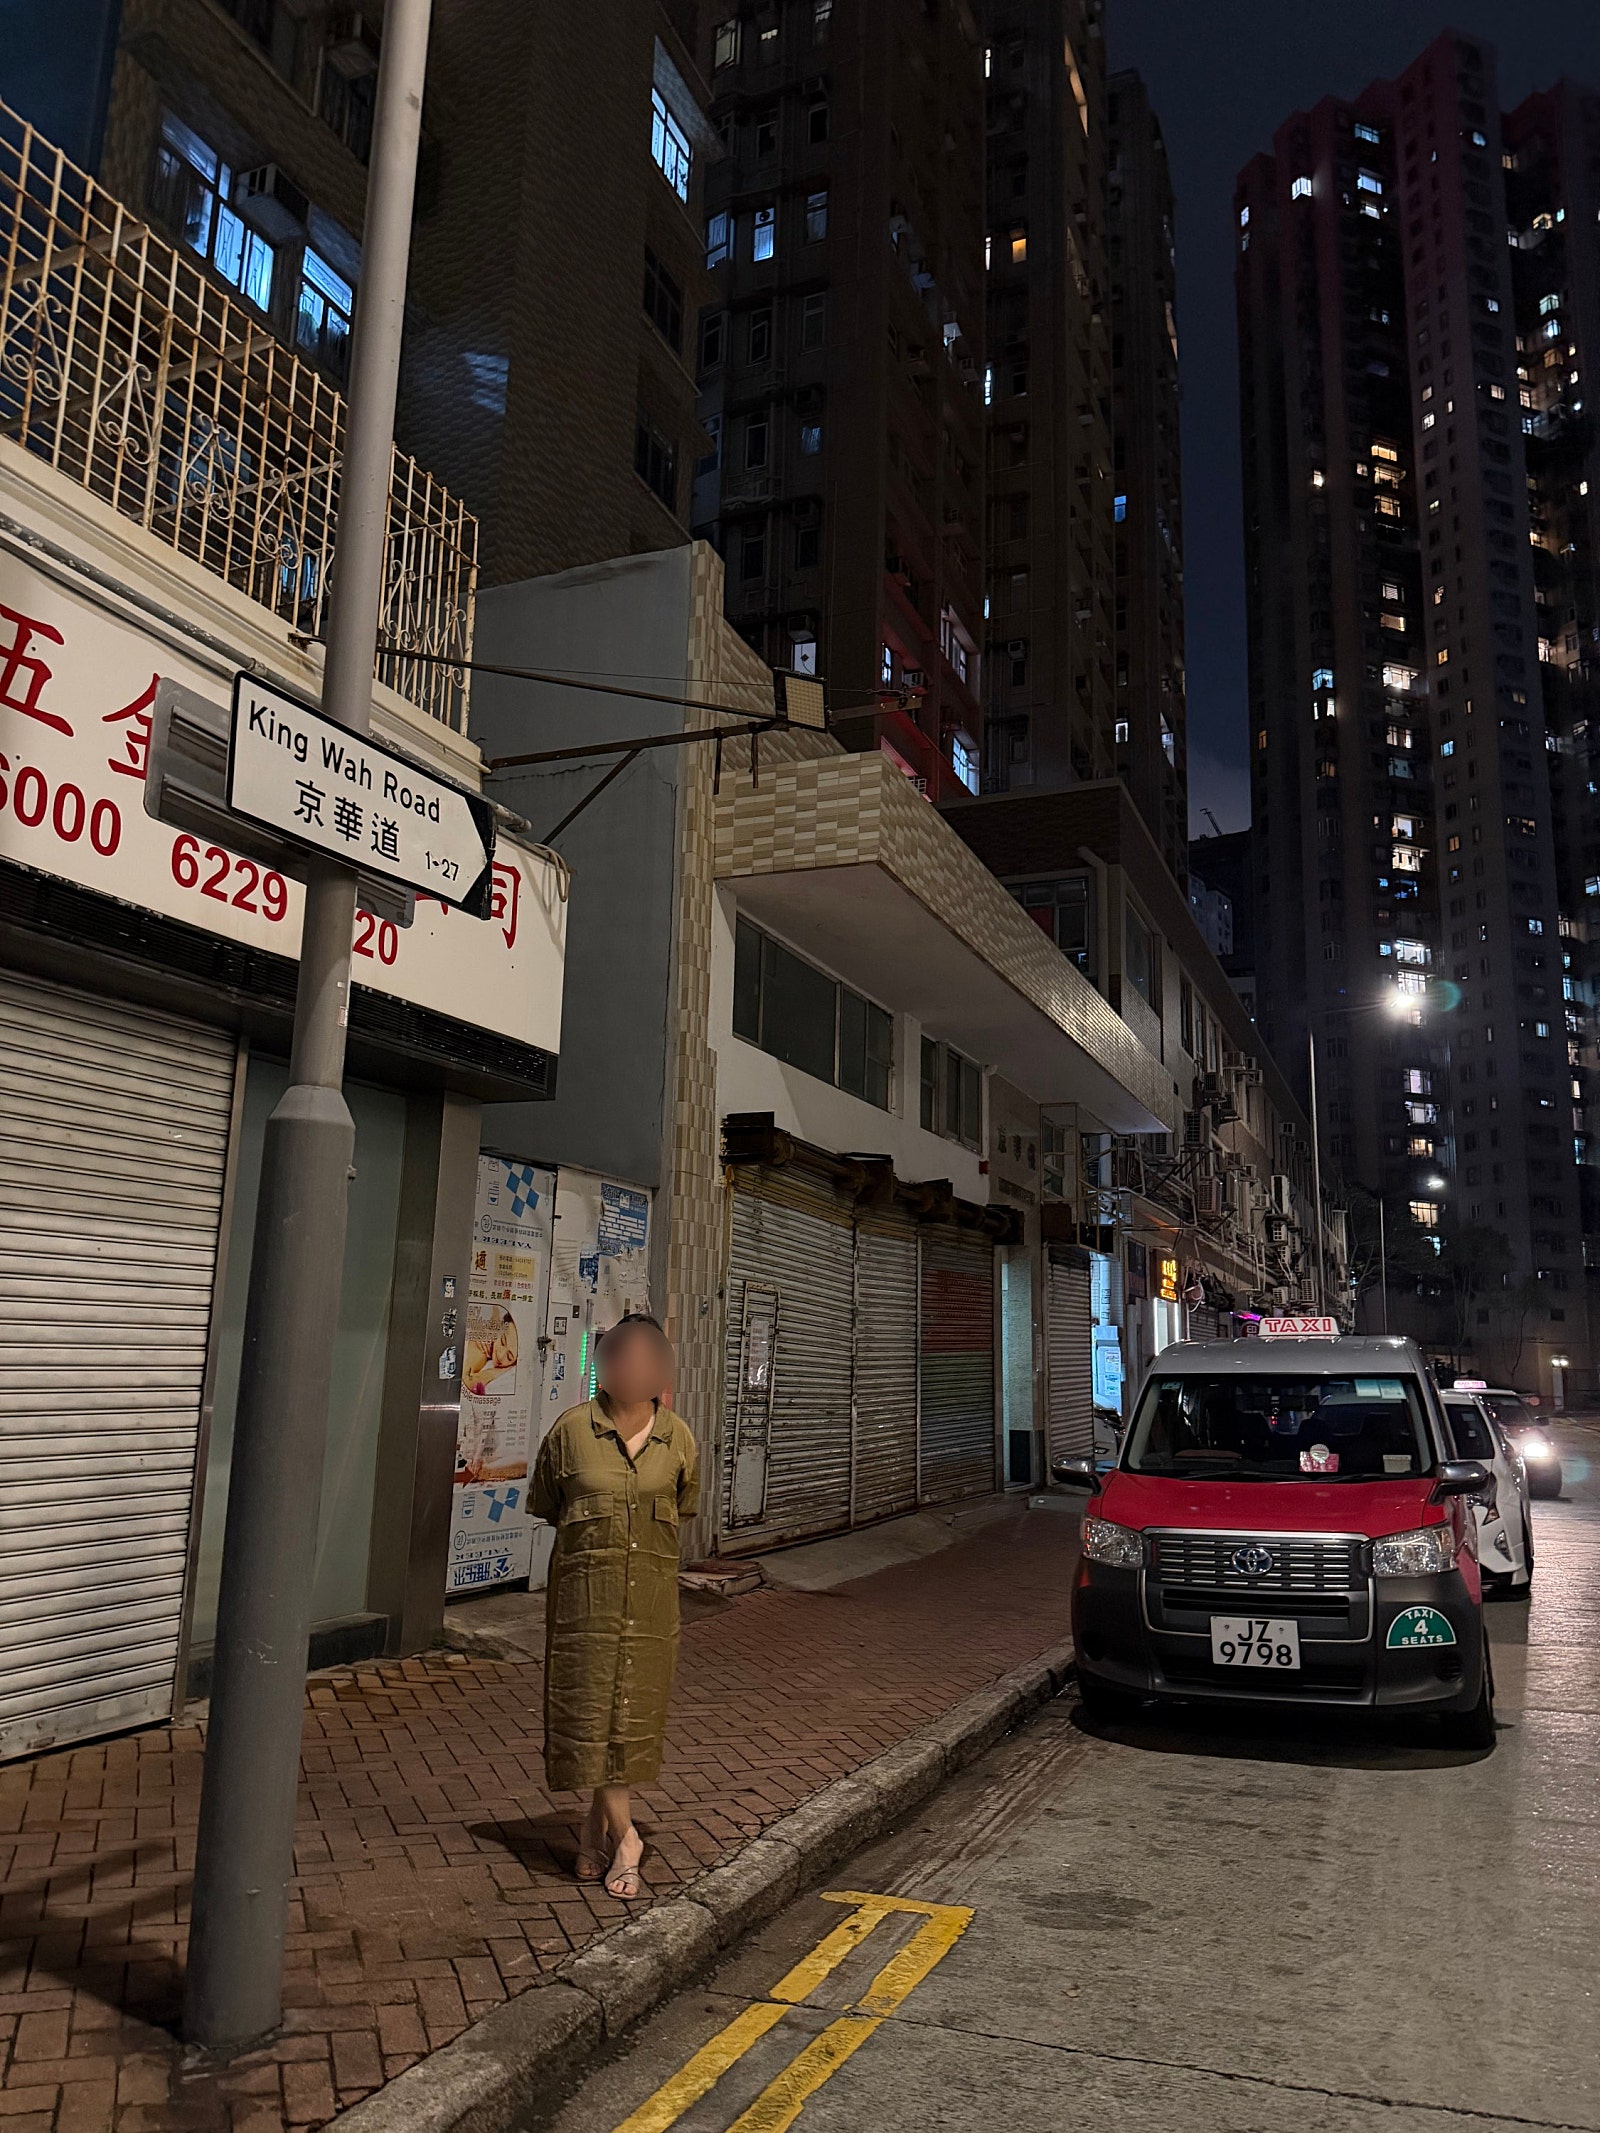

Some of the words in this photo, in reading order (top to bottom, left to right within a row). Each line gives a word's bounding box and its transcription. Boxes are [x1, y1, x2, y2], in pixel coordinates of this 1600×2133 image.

[249, 700, 309, 763] King
[321, 736, 372, 791] Wah
[383, 770, 441, 824] Road
[293, 780, 401, 863] 京華道
[0, 753, 122, 858] 000
[171, 833, 289, 923] 6229
[352, 910, 399, 966] 20
[425, 850, 460, 882] 1-27
[482, 1236, 532, 1249] YALEER
[1264, 1318, 1333, 1333] TAXI
[472, 1396, 502, 1407] massage
[1404, 1609, 1434, 1620] TAXI
[1237, 1620, 1273, 1643] JZ
[1414, 1619, 1429, 1635] 4
[1401, 1634, 1444, 1645] SEATS
[1219, 1640, 1293, 1667] 9798
